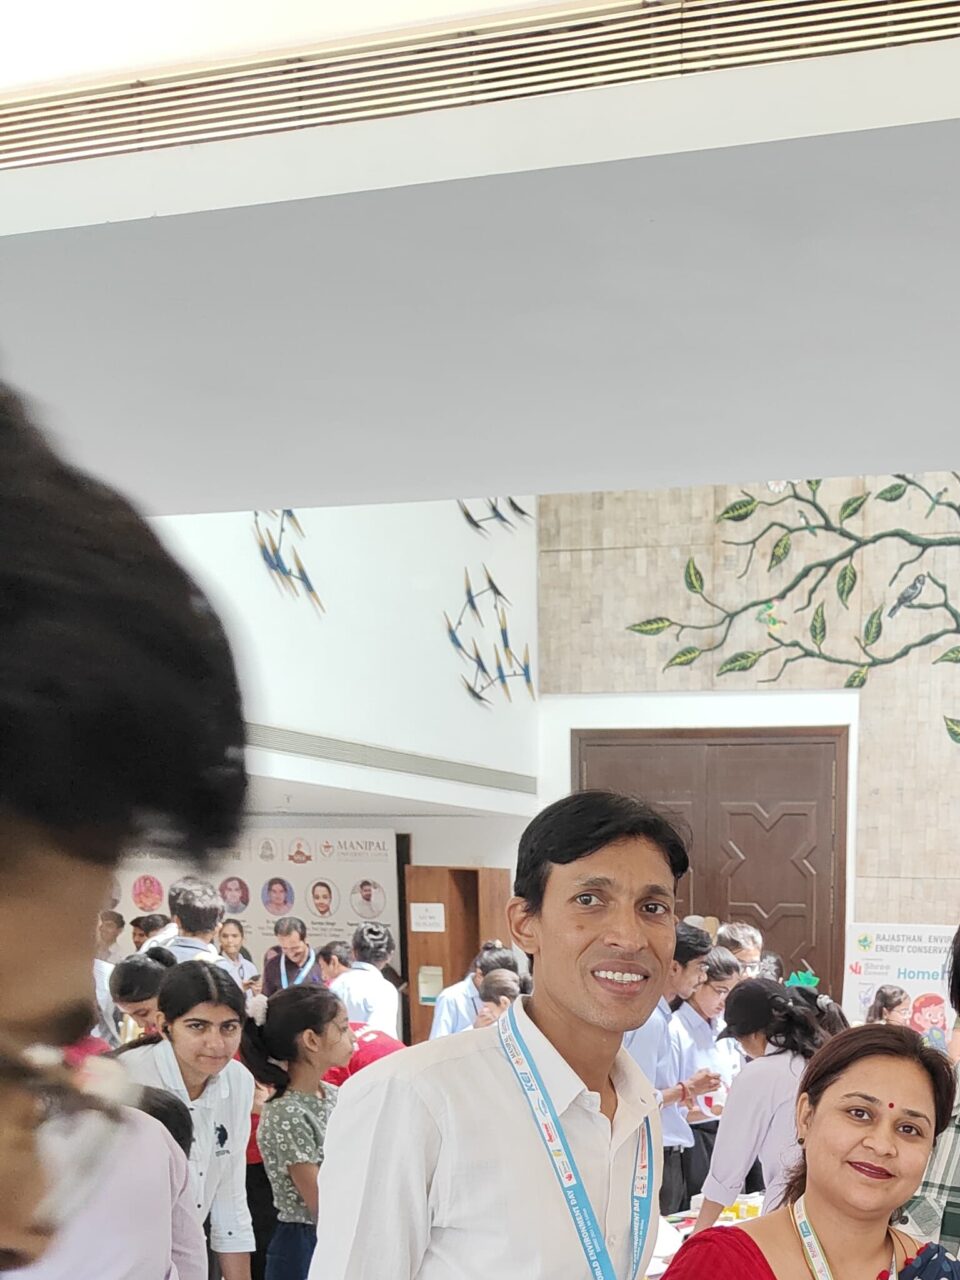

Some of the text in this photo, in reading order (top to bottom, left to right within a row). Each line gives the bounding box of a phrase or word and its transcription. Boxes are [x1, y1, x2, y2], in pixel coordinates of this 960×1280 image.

[336, 840, 388, 851] MANIPAL
[876, 933, 922, 943] RAJASTHAN
[876, 944, 951, 954] ENERGY CONSERVA
[520, 1072, 535, 1091] KEI
[566, 1190, 577, 1206] DAY
[572, 1206, 597, 1260] ENVIRONMENT
